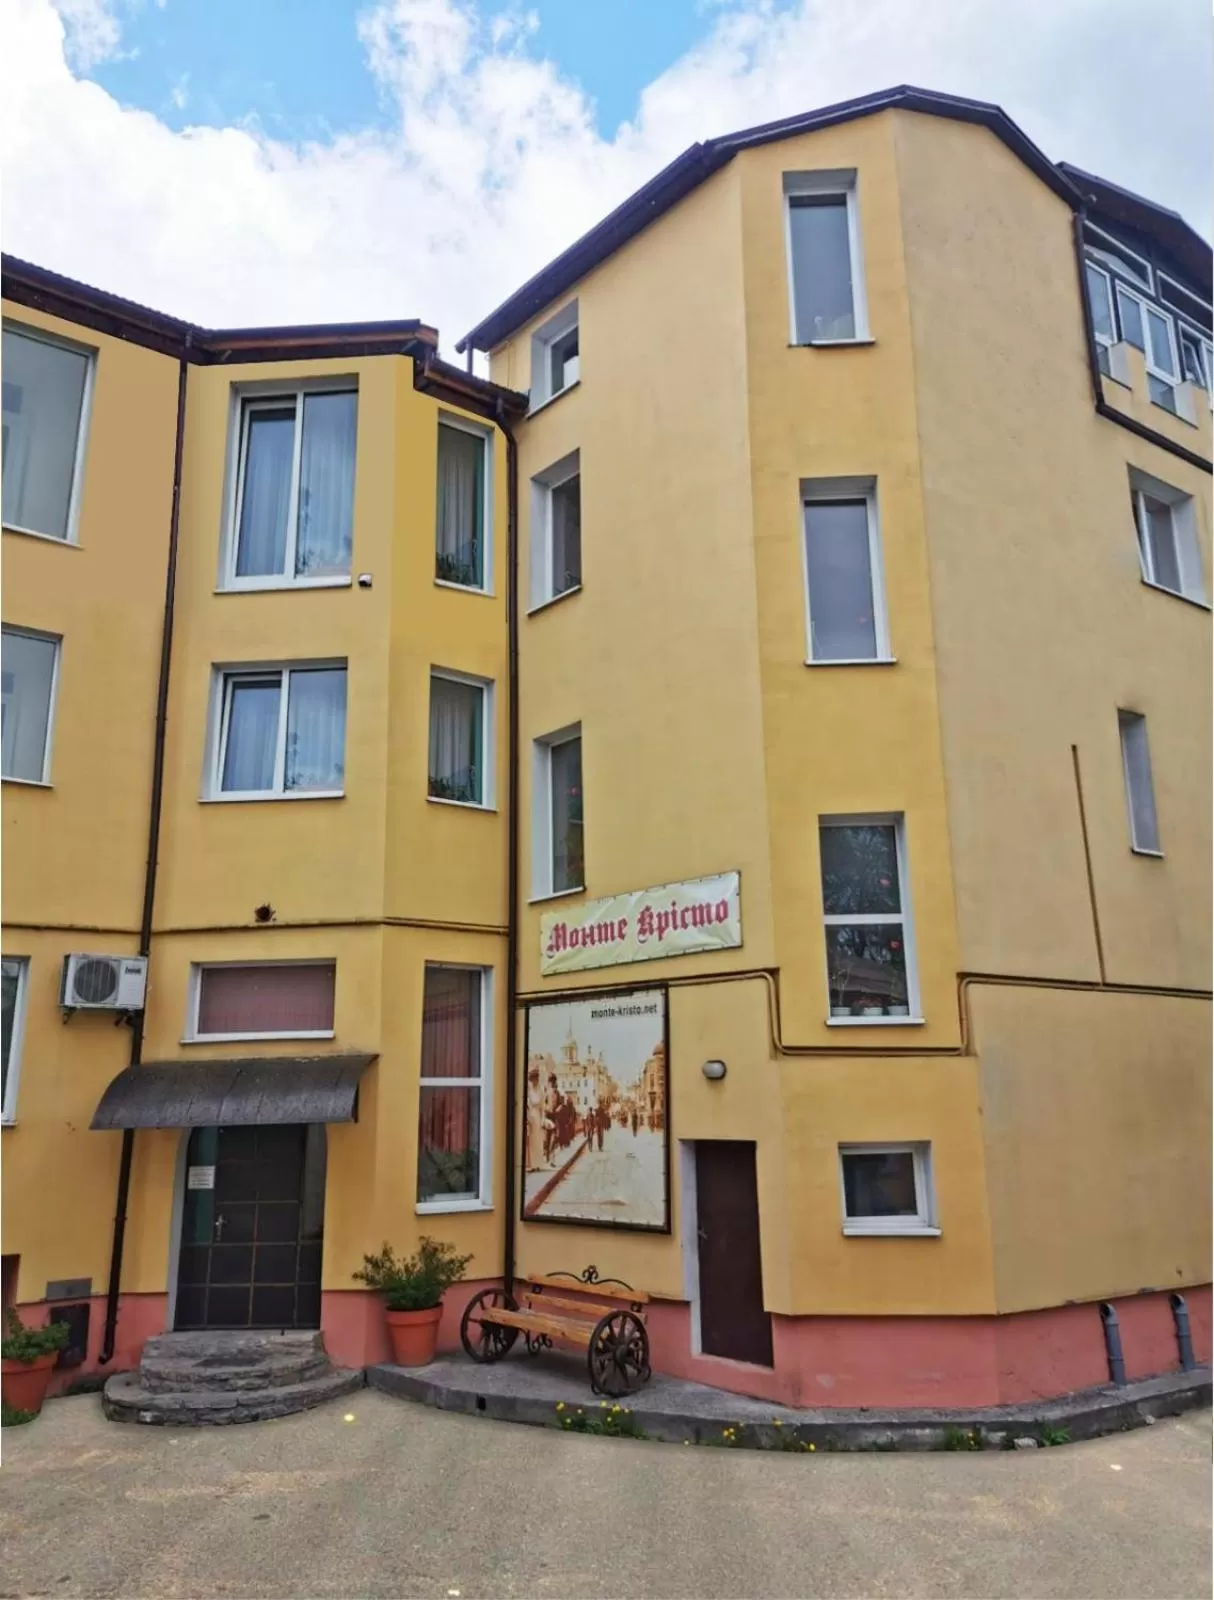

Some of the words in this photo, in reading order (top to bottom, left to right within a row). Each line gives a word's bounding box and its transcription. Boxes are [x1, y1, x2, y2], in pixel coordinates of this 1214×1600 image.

[546, 917, 629, 959] Монте
[636, 898, 729, 944] Крісто
[591, 1003, 657, 1018] monte-kristo.net
